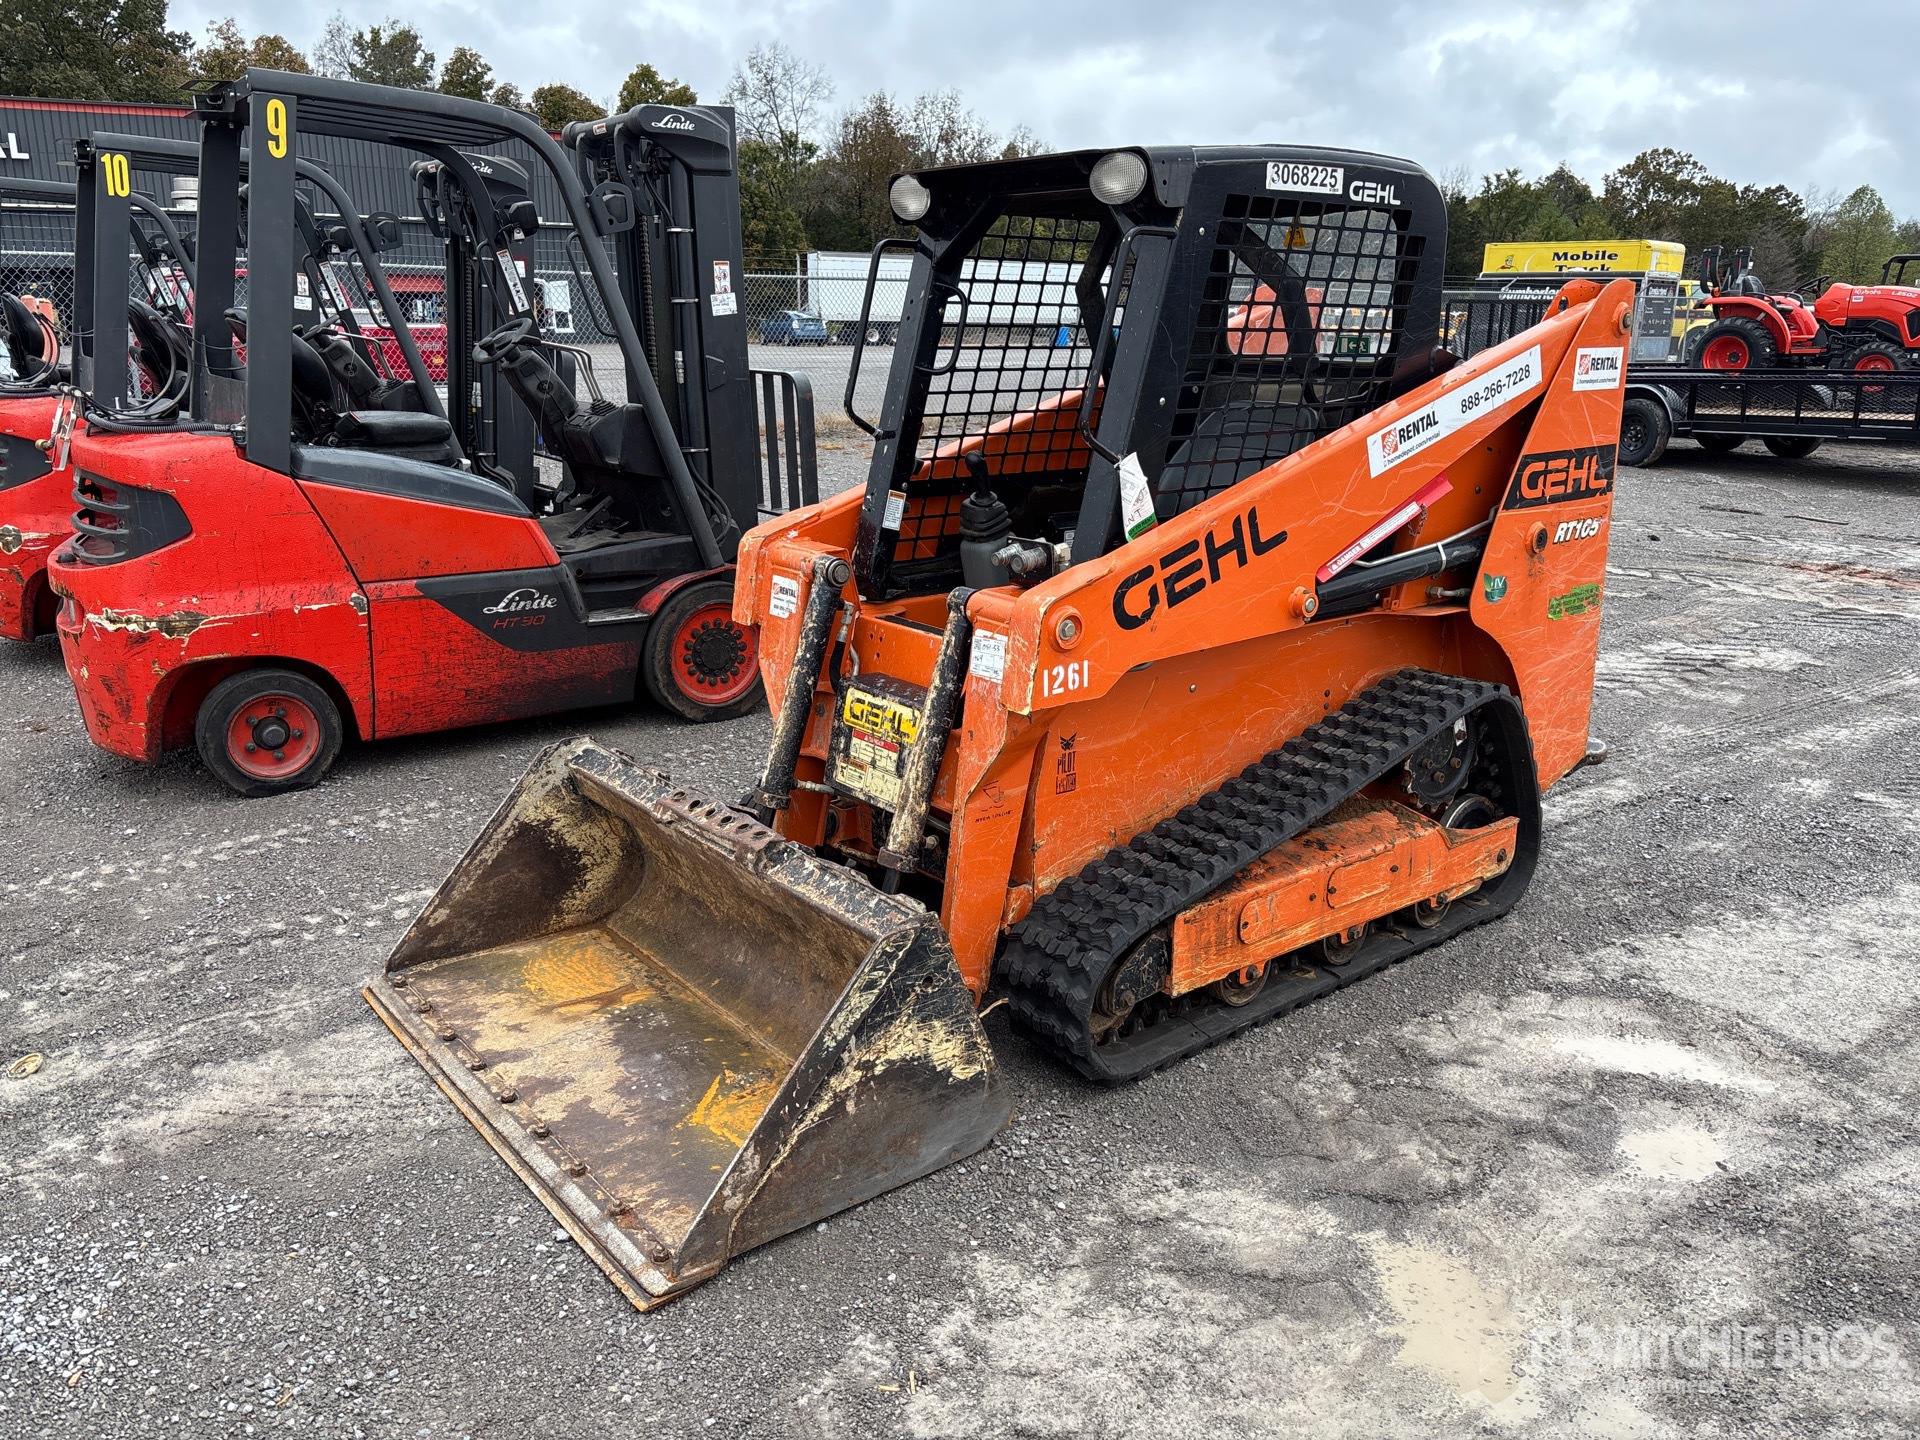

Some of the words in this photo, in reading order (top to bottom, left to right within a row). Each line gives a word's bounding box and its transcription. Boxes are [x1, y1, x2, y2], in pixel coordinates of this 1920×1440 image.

[267, 98, 287, 158] 9
[651, 113, 695, 131] Linde
[0, 133, 30, 160] L
[101, 153, 130, 197] 10
[1271, 163, 1339, 189] 3068225
[1349, 180, 1401, 205] GEHL
[1552, 250, 1618, 261] Mobile
[1590, 356, 1619, 371] RENTAL
[1460, 363, 1531, 415] 888-266-7228
[1398, 410, 1439, 445] RENTAL
[1521, 454, 1607, 499] GEHL
[1553, 517, 1600, 545] RT105
[1112, 505, 1288, 631] GEHL
[483, 588, 557, 614] Linde
[1042, 659, 1089, 698] 1261
[849, 697, 911, 740] GEHL
